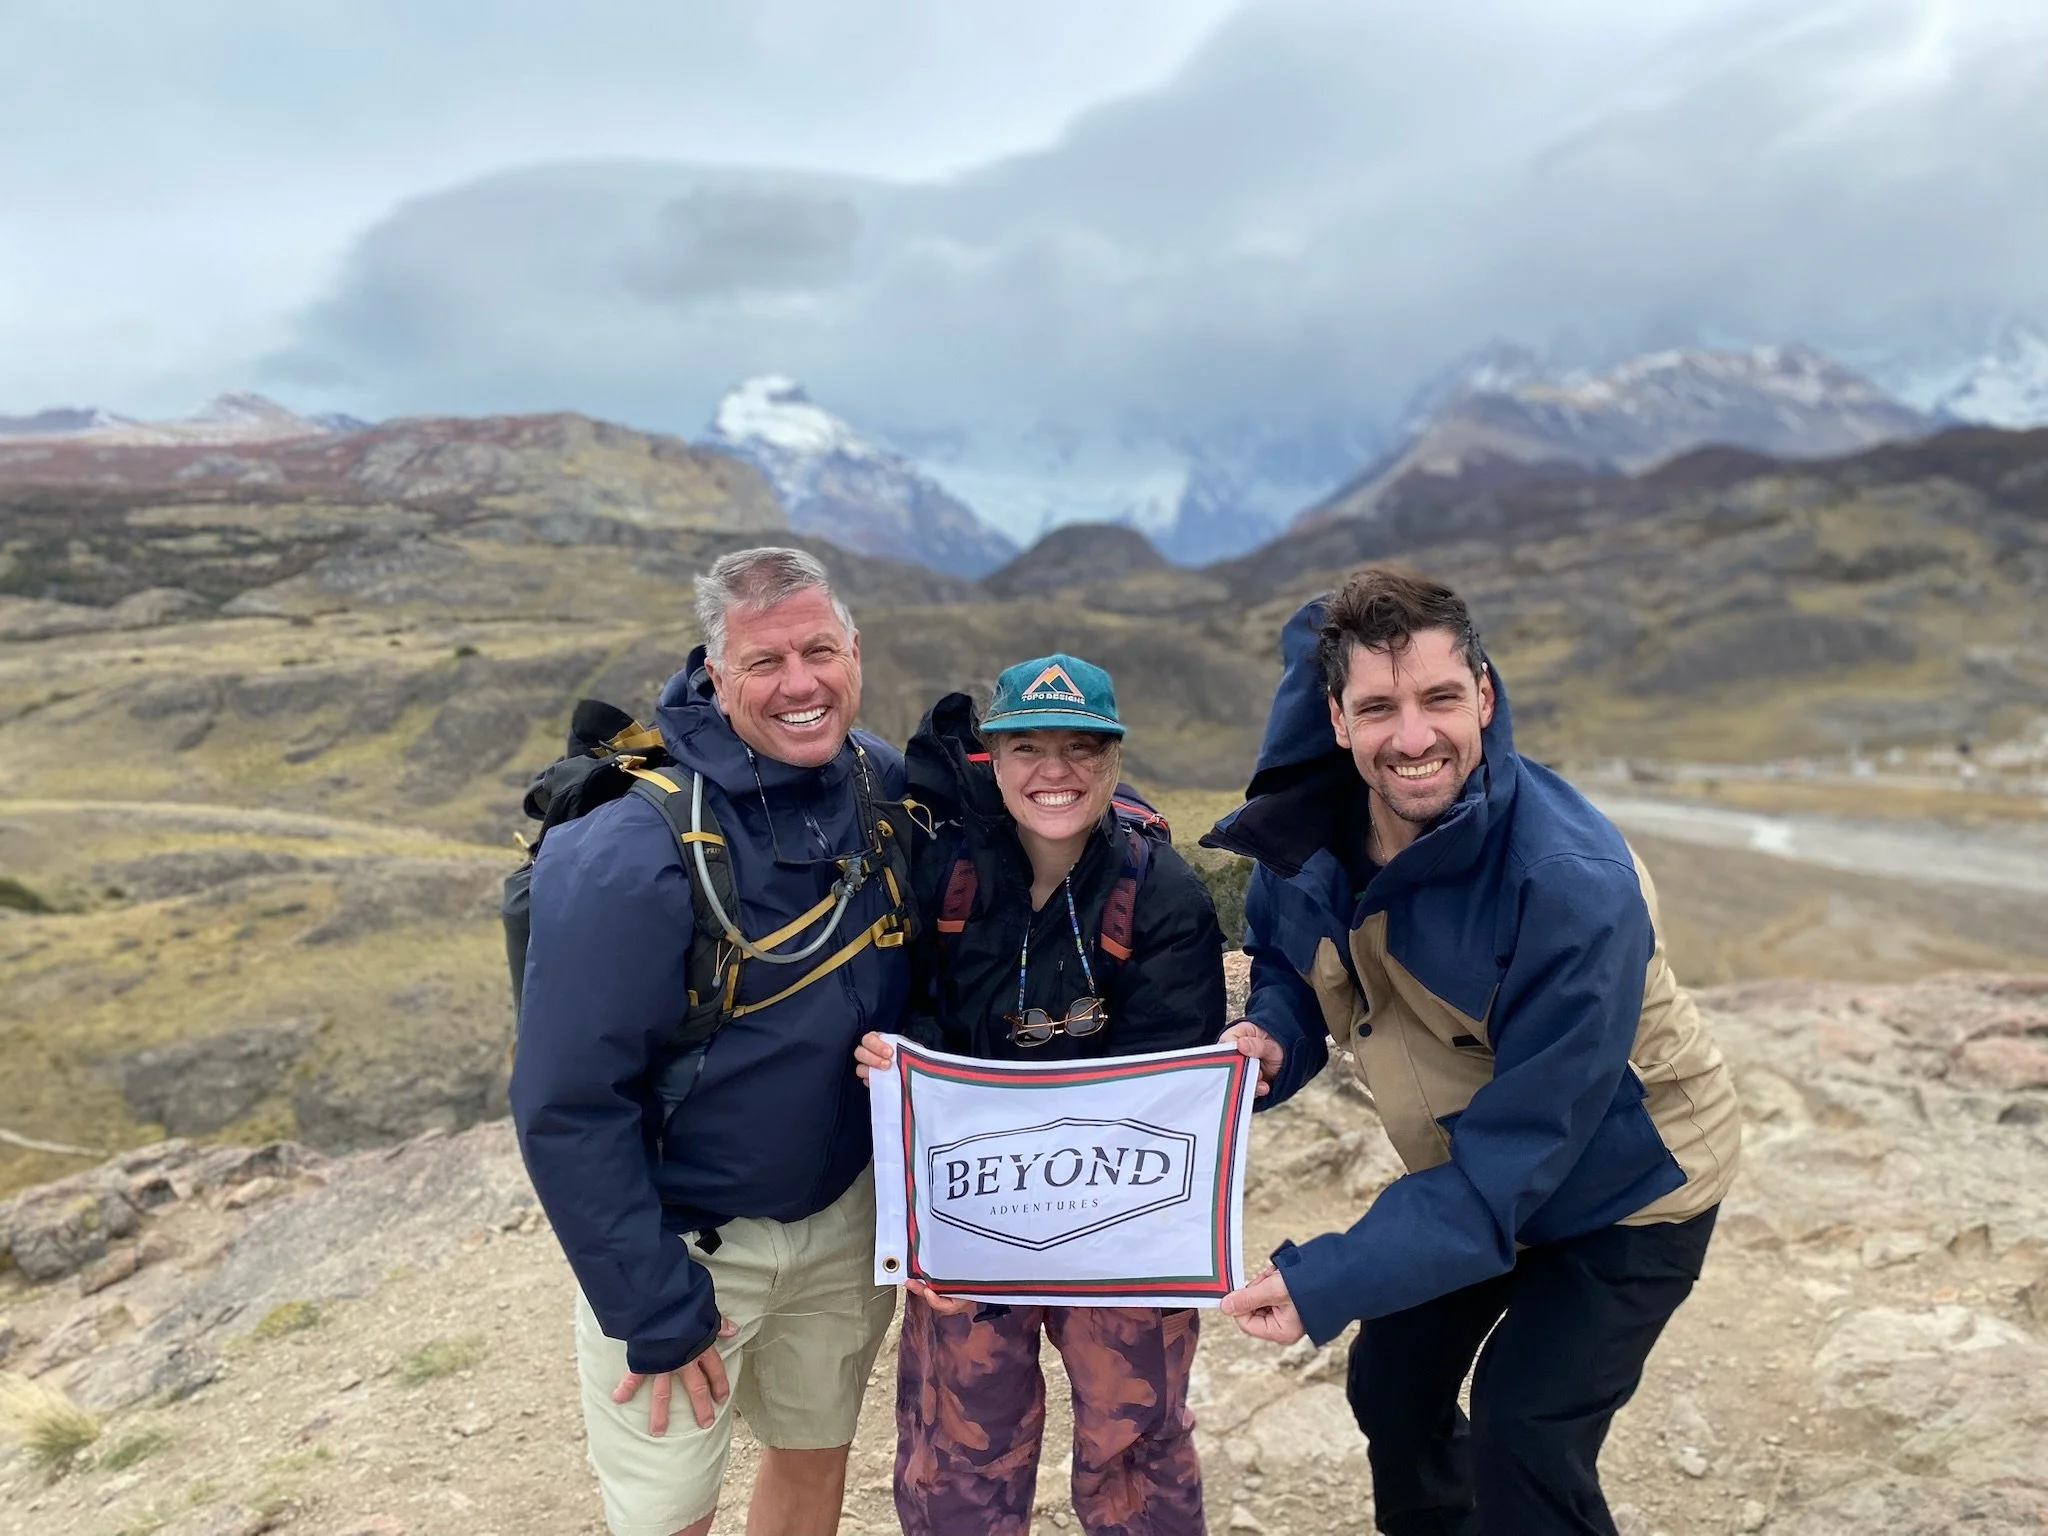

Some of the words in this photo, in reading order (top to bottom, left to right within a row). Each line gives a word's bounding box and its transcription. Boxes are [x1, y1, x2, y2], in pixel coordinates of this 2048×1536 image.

[1022, 693, 1045, 702] TOPO
[1046, 693, 1086, 705] DESIGNS
[946, 1147, 1171, 1200] BEYOND
[989, 1198, 1099, 1216] ADVENTURES
